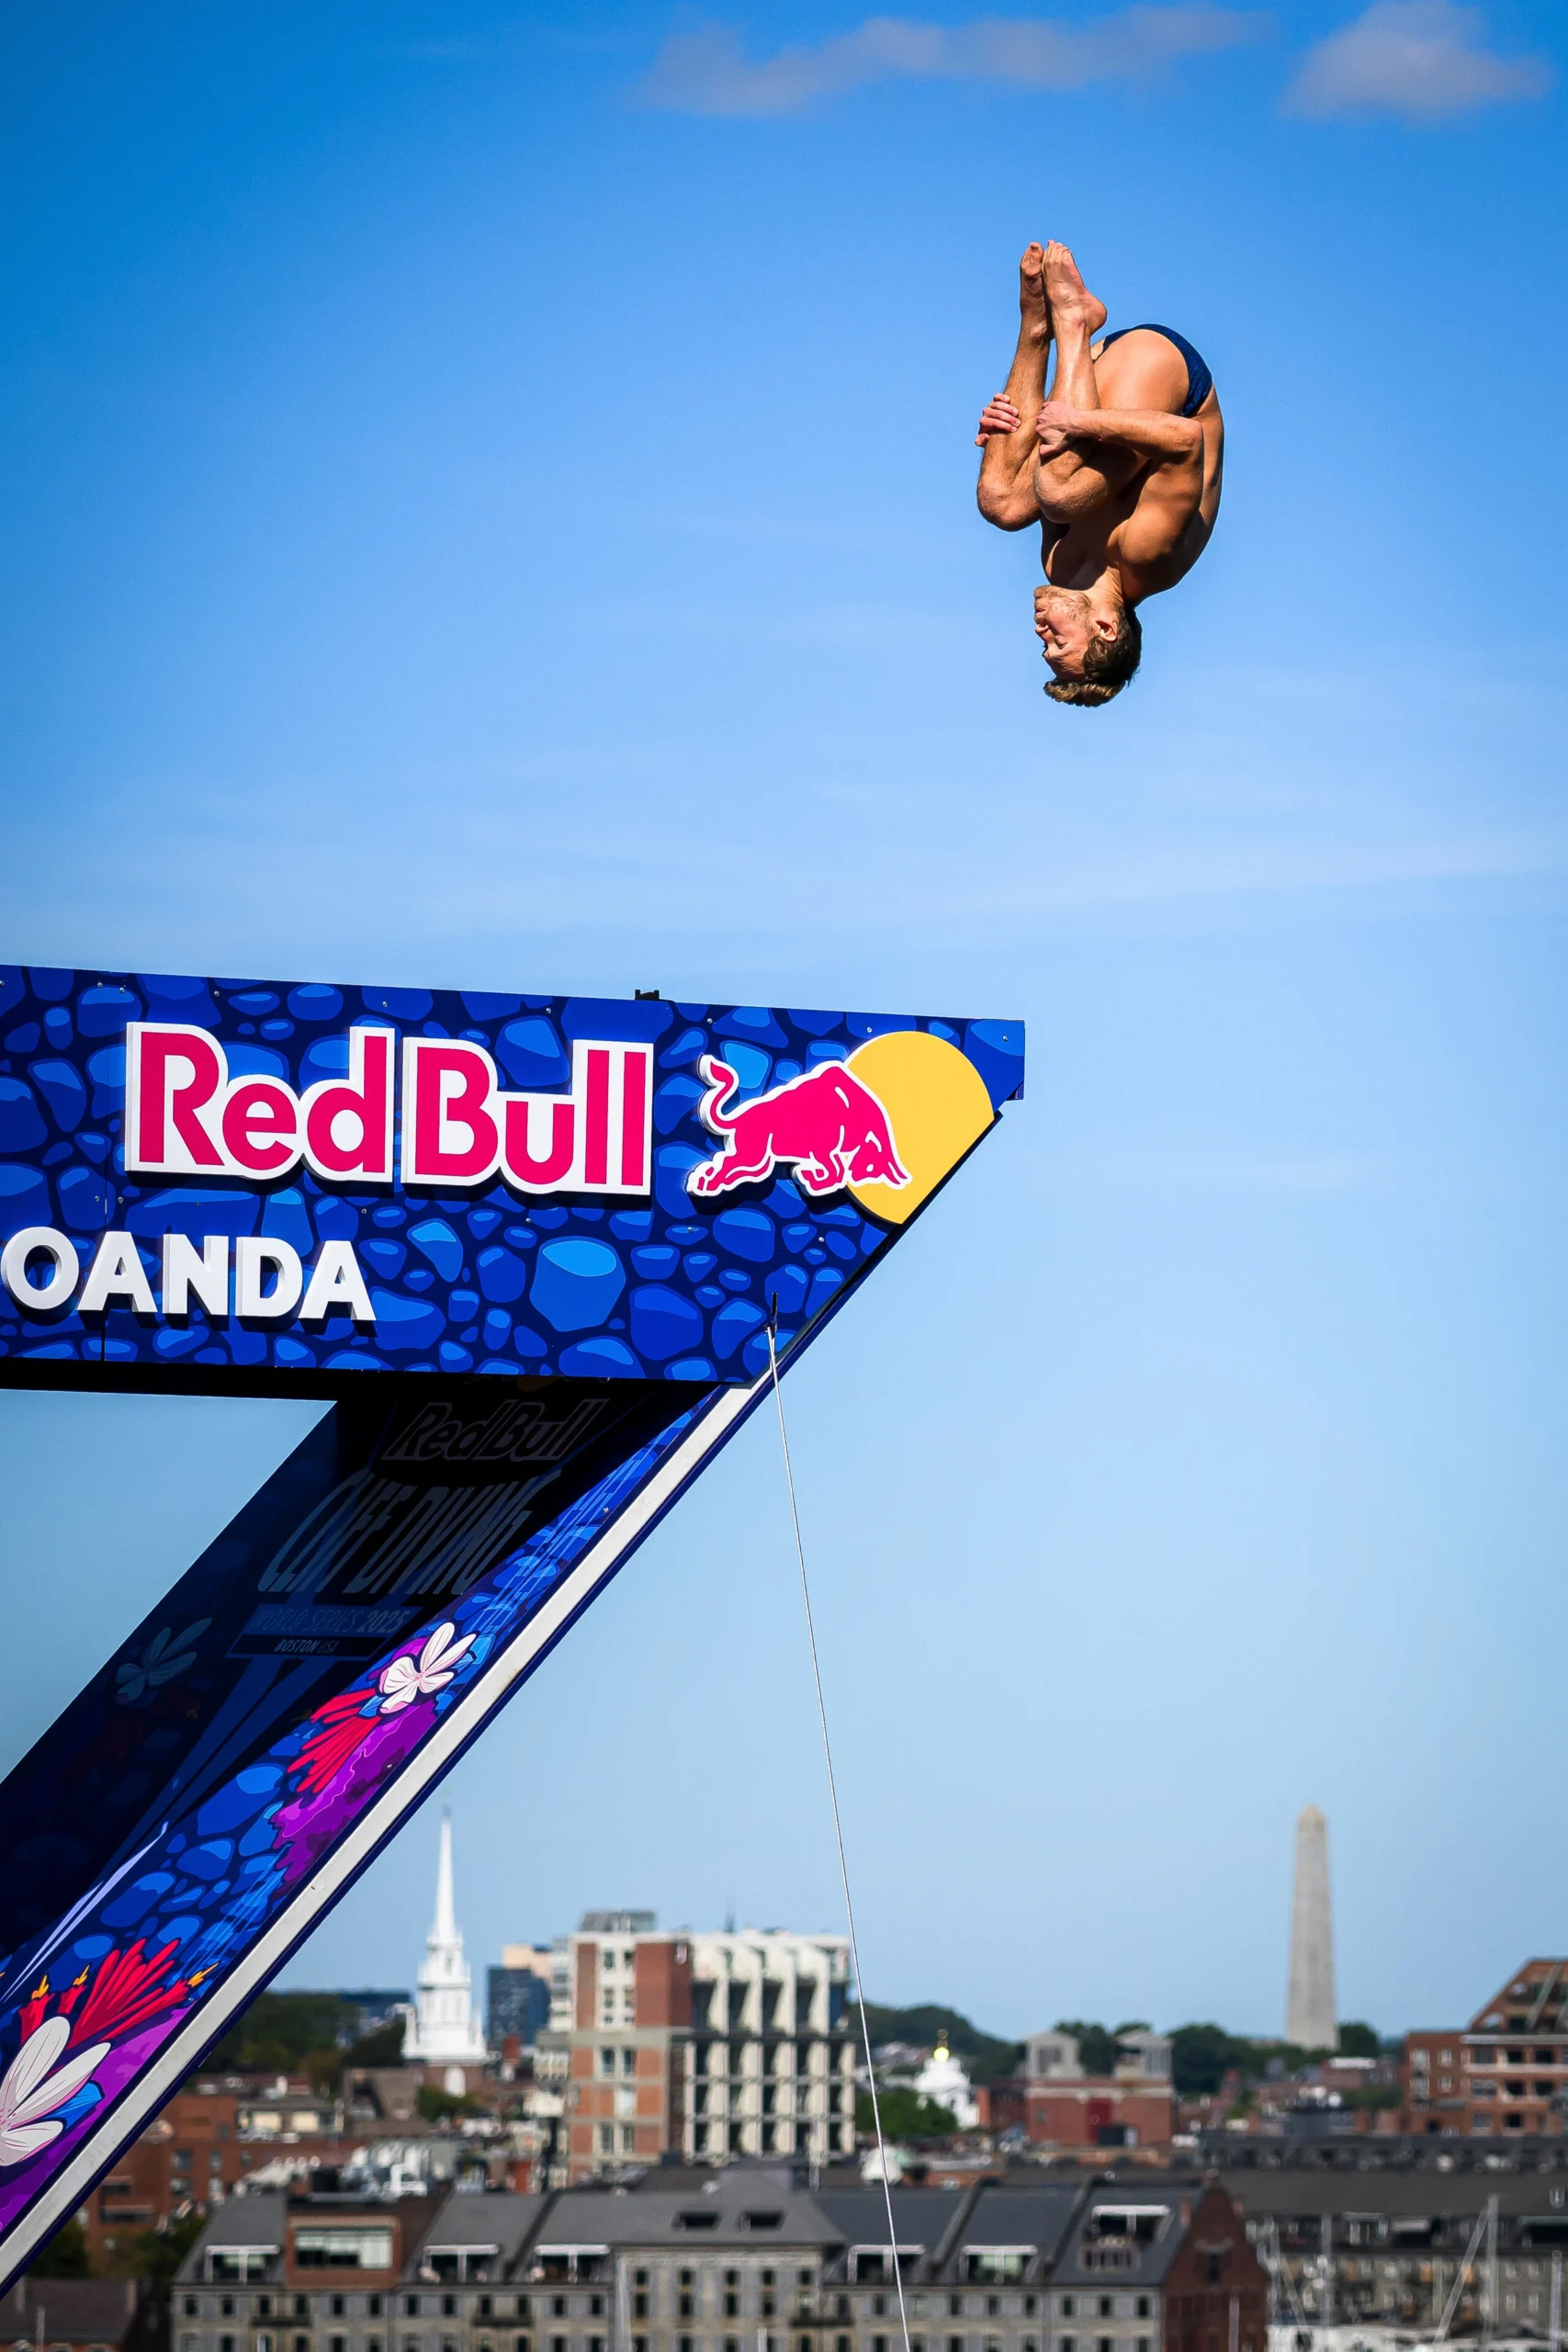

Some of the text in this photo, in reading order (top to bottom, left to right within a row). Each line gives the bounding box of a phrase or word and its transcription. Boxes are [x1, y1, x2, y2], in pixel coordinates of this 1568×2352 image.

[126, 1022, 654, 1195] Red Bull
[1, 1226, 377, 1321] OANDA
[257, 1467, 562, 1594] CLIFF DIVING
[247, 1607, 412, 1634] WORLD SERIES 2025
[274, 1639, 340, 1654] BOSTON USA
